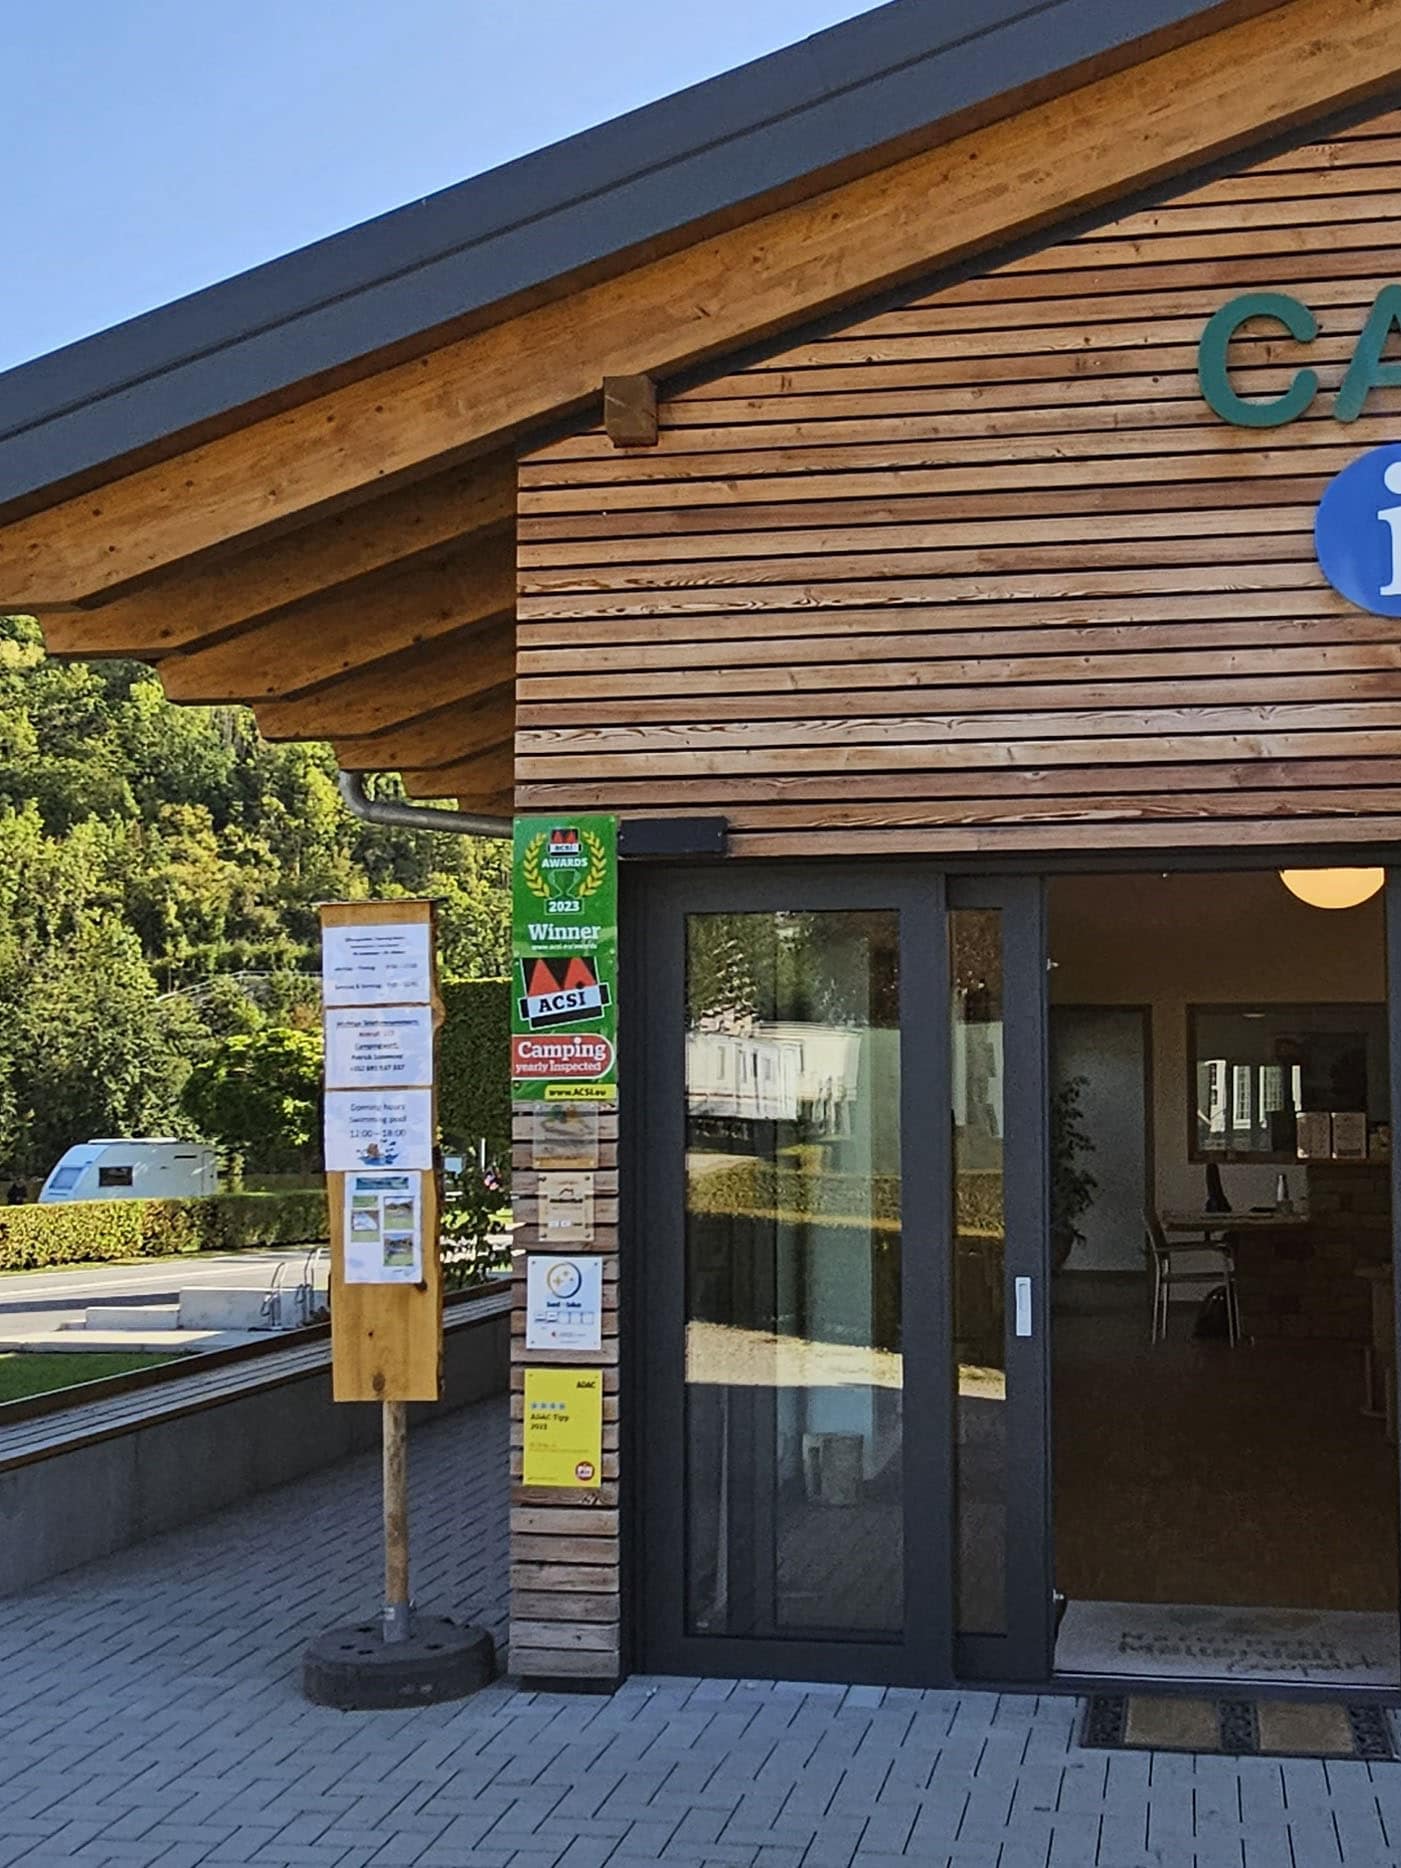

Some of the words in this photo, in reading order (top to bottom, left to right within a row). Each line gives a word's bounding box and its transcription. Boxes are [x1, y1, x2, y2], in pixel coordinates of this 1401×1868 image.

[541, 857, 588, 868] AWARDS
[548, 900, 580, 912] 2023
[528, 923, 600, 941] Winner
[538, 991, 587, 1013] ACSI
[518, 1037, 606, 1060] Camping
[515, 1061, 549, 1073] yearly
